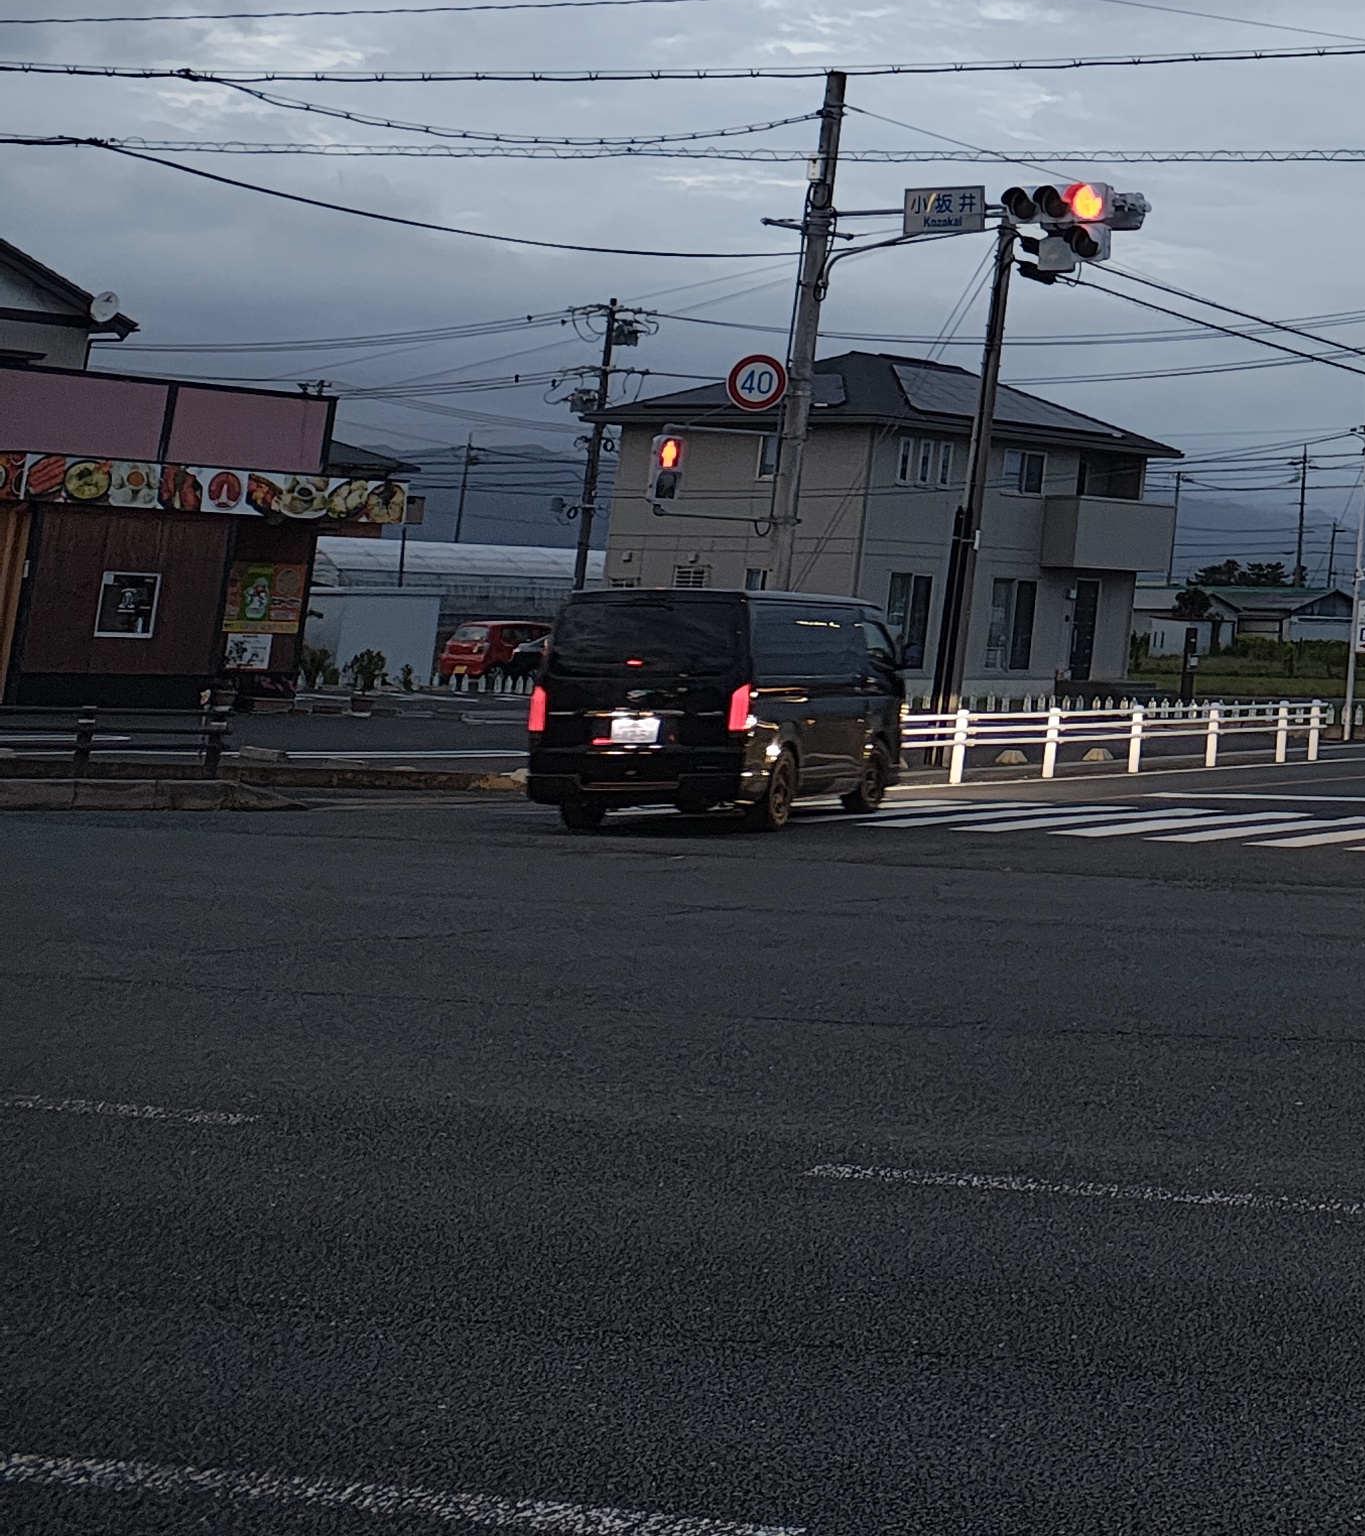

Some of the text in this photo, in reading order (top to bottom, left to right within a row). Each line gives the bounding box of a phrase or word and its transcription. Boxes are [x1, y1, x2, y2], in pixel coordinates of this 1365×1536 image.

[911, 193, 976, 214] 小坂井
[740, 369, 773, 394] 40
